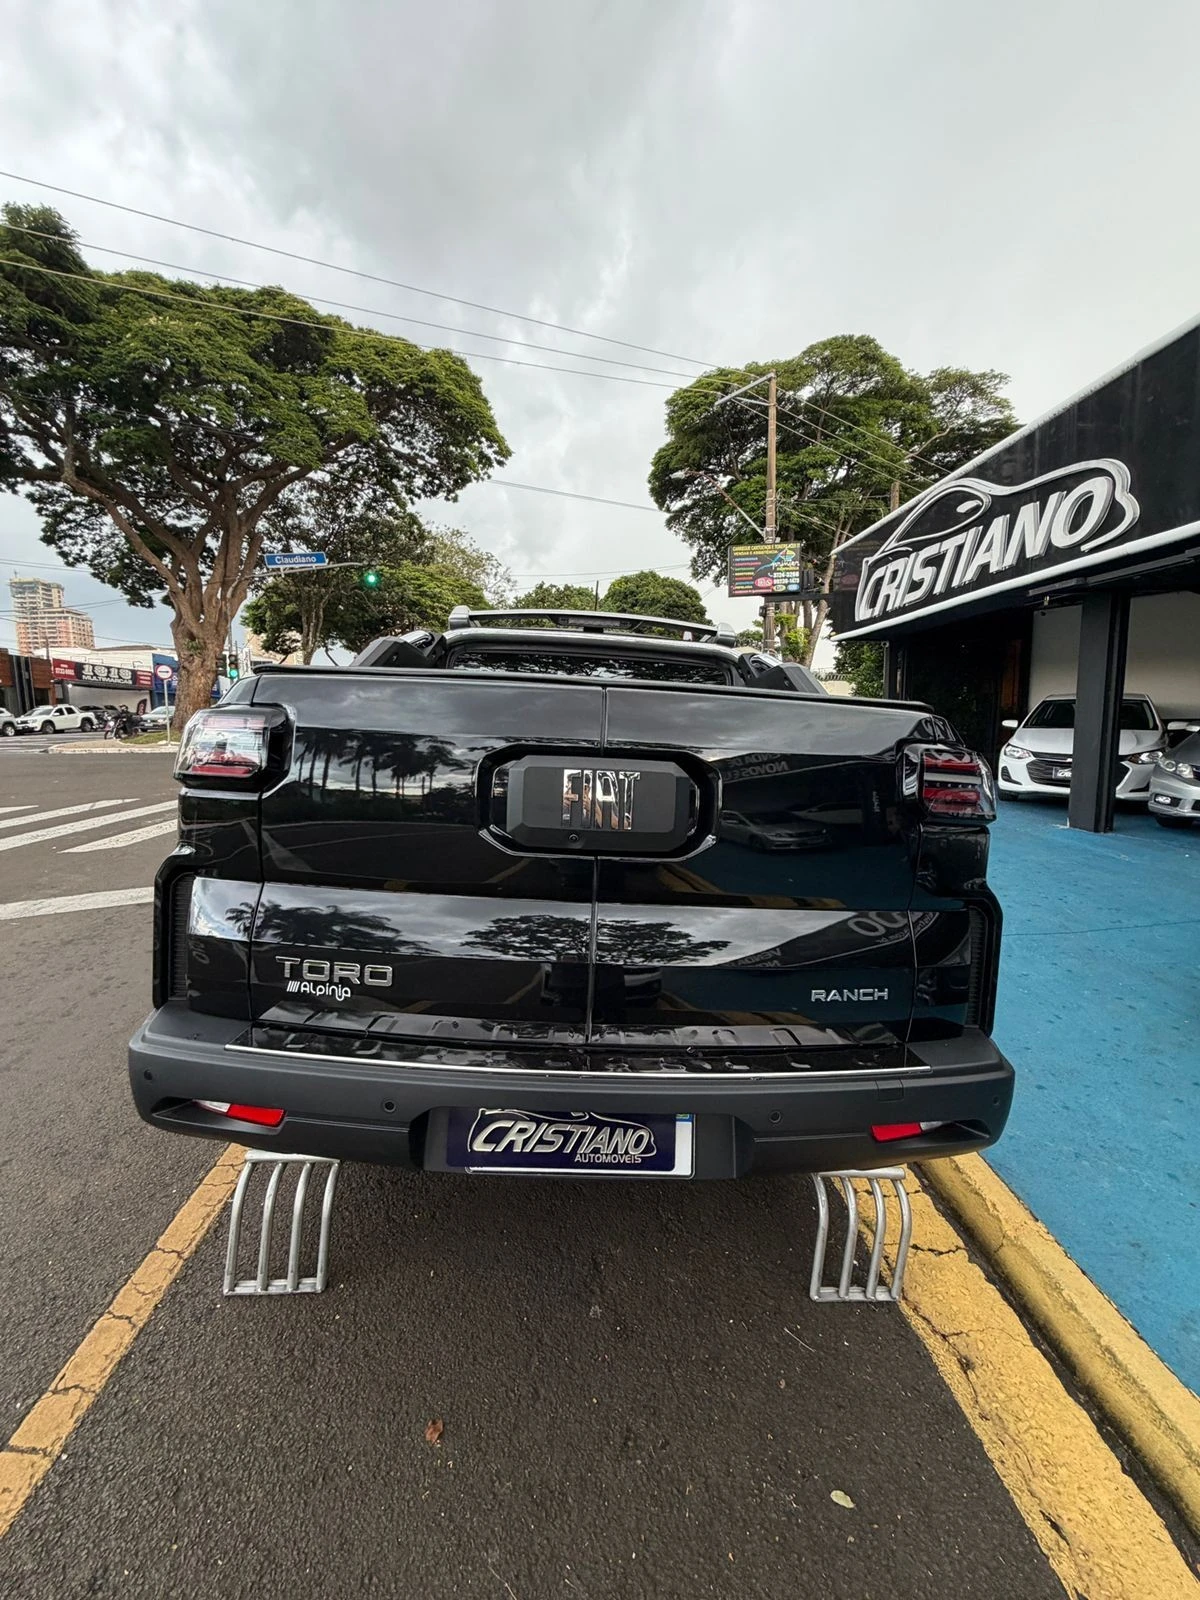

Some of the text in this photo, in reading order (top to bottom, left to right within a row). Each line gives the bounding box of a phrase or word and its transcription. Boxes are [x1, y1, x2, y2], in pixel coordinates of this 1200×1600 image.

[859, 476, 1115, 620] CRISTIANO
[275, 556, 317, 564] Claudiano
[82, 675, 132, 685] MULTIMARCAS
[562, 769, 640, 829] FIAT
[275, 956, 393, 987] TORO
[811, 987, 888, 1002] RANCH
[472, 1119, 650, 1155] CRISTIANO
[574, 1153, 642, 1164] AUTOMOVEIS
